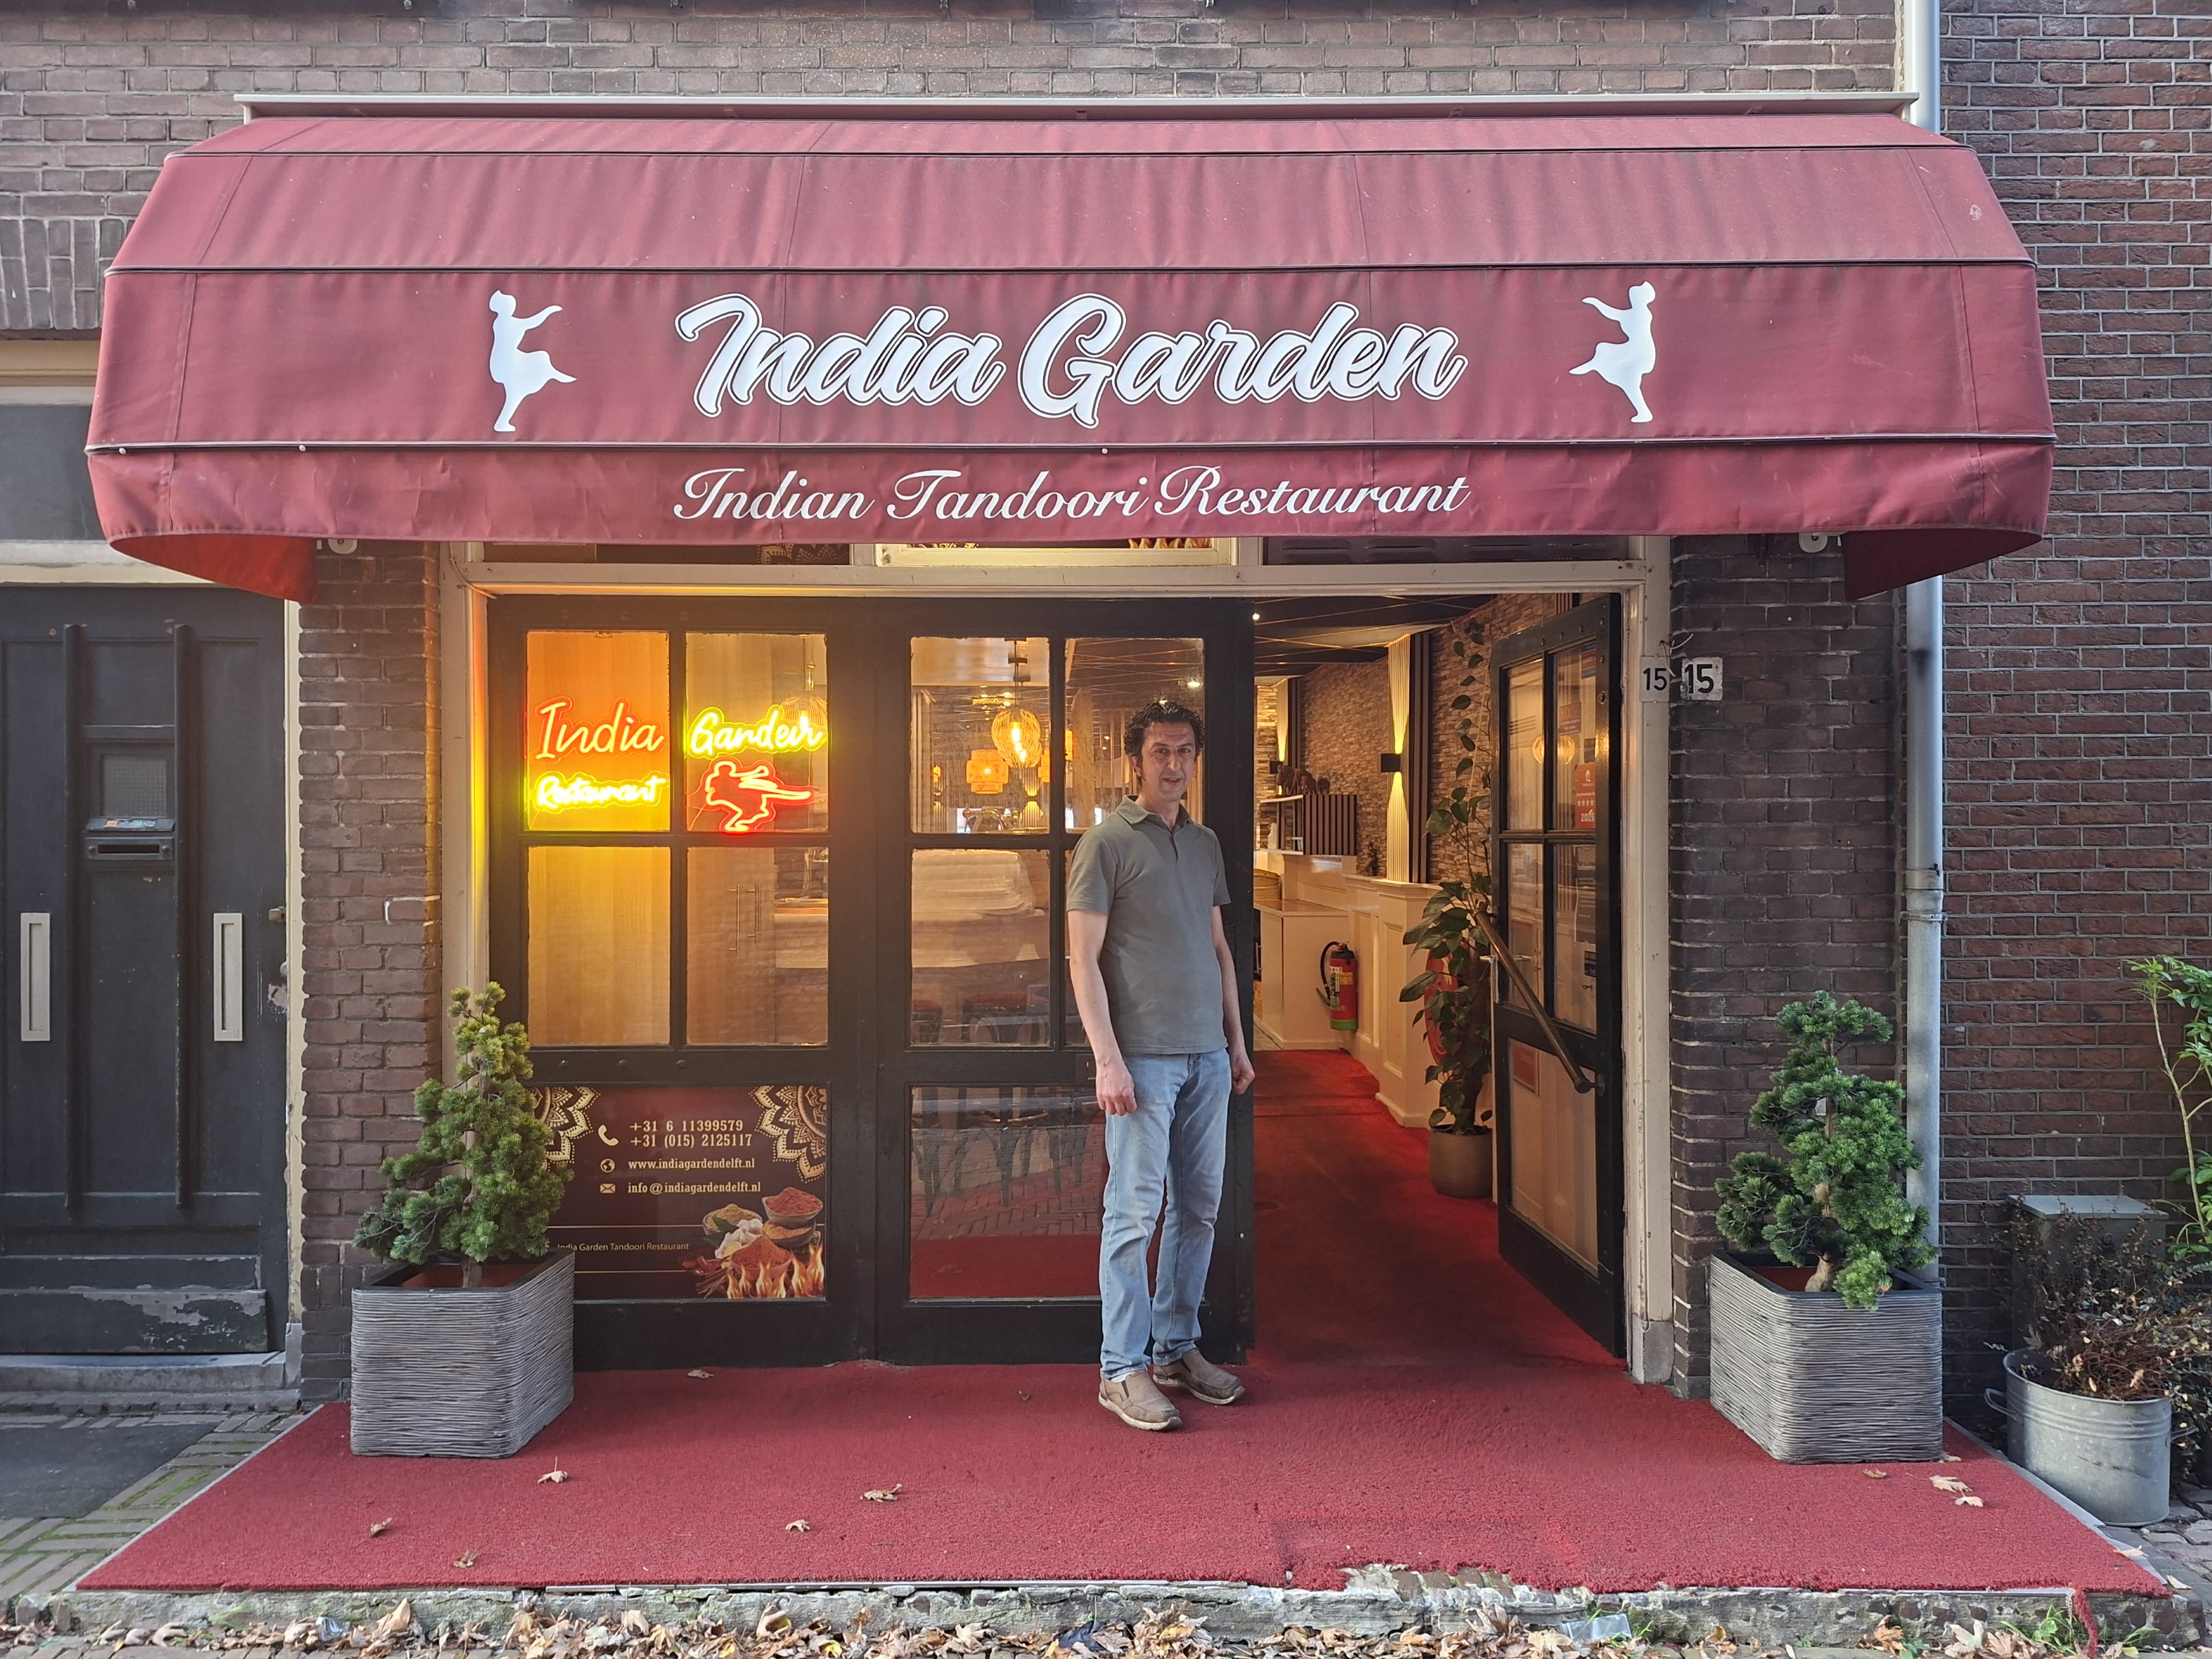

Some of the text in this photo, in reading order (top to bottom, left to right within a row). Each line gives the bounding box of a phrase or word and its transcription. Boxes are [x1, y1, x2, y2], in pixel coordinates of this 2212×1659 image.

[675, 292, 1468, 430] India Garden
[673, 465, 1472, 520] Indian Tandoori Restaurant
[1643, 668, 1667, 691] 15
[1685, 664, 1714, 694] 15
[535, 701, 665, 760] India
[536, 774, 667, 810] Restaurant
[630, 1120, 743, 1132] +31 6 11399579
[630, 1133, 752, 1149] +31 (015) 2125117
[628, 1158, 755, 1170] www.indiagardendelft.nl
[628, 1182, 761, 1194] info@indiagardendelft.nl
[578, 1243, 609, 1251] Garden
[647, 1242, 690, 1251] Restaurant
